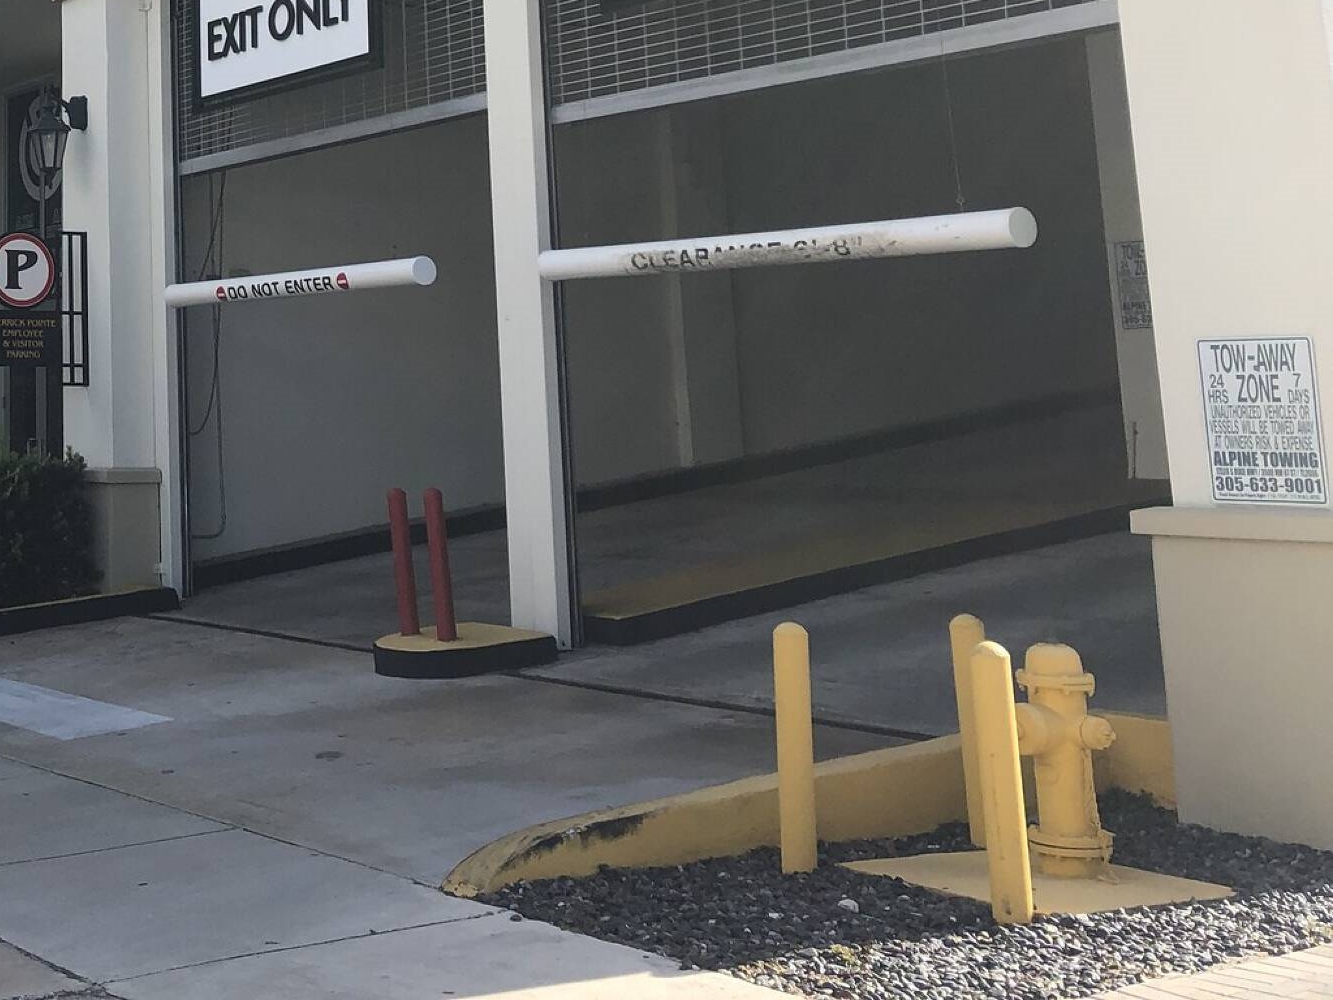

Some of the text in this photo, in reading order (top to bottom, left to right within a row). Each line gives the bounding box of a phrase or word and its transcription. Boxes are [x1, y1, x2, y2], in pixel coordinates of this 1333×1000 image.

[207, 5, 263, 62] EXIT
[4, 249, 38, 290] P
[227, 275, 335, 300] DO NOT ENTER
[27, 318, 57, 328] POINTE
[2, 329, 44, 337] EMPLOYEE
[2, 339, 44, 347] & VISITOR
[6, 350, 41, 358] PARKING
[1210, 343, 1296, 373] TOW-AWAY
[1208, 373, 1301, 403] 24 ZONE 7
[1207, 389, 1310, 404] HRS DAYS
[1210, 405, 1310, 419] UNAUTHORIZED VEHICLES OR
[1209, 420, 1239, 434] VESSELS
[1242, 420, 1256, 434] WILL
[1258, 420, 1268, 434] BE
[1270, 420, 1294, 435] TOWED
[1214, 435, 1222, 449] AT
[1225, 435, 1253, 449] OWNERS
[1254, 436, 1272, 449] RISK
[1281, 436, 1314, 450] EXPENSE
[1214, 451, 1319, 468] ALPINE TOWING
[1215, 476, 1322, 494] 305-633-9001
